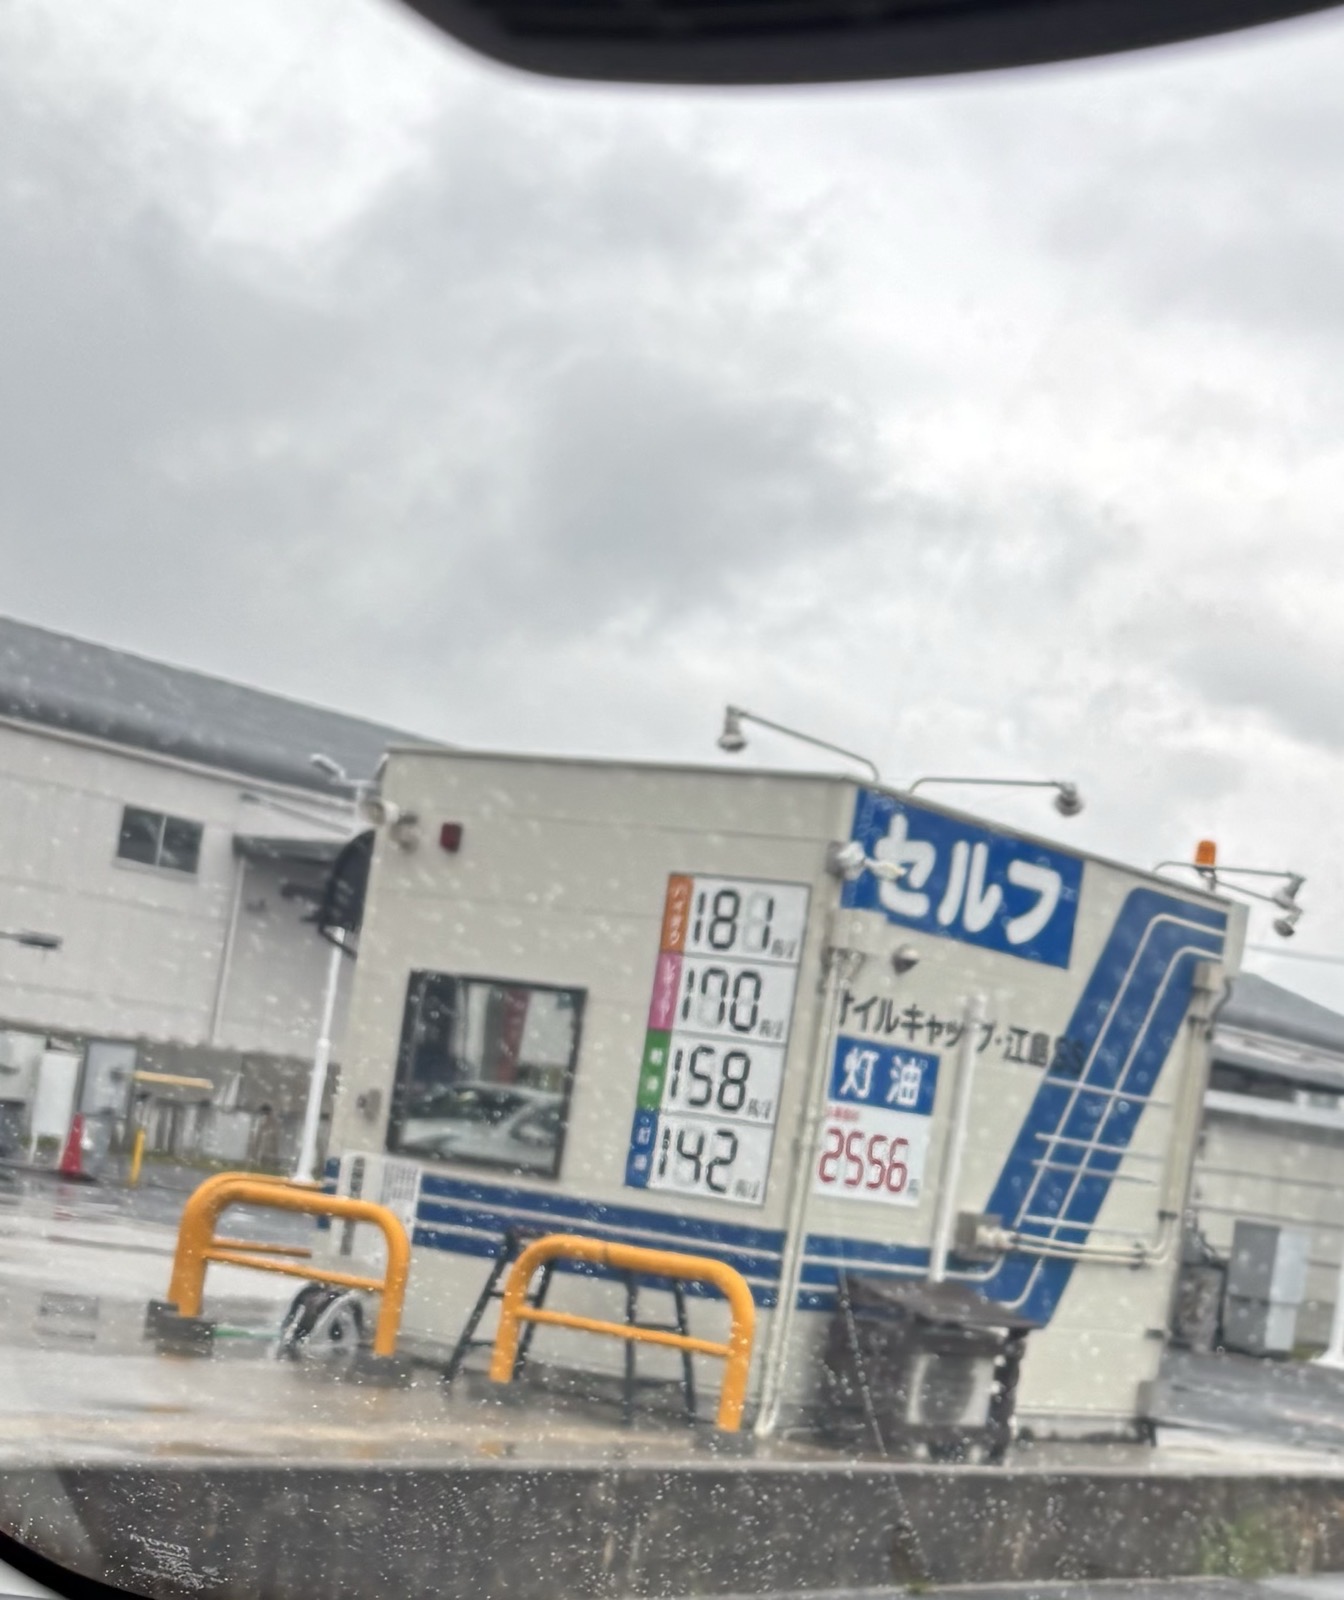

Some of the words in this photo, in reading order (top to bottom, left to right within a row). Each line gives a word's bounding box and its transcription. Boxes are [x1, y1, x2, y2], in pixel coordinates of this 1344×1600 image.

[874, 813, 1063, 945] セルフ
[694, 889, 775, 950] 181
[682, 967, 762, 1032] 170
[671, 1043, 751, 1112] 158
[840, 1047, 924, 1107] 灯油
[659, 1127, 739, 1193] 142
[818, 1126, 909, 1193] 2556
